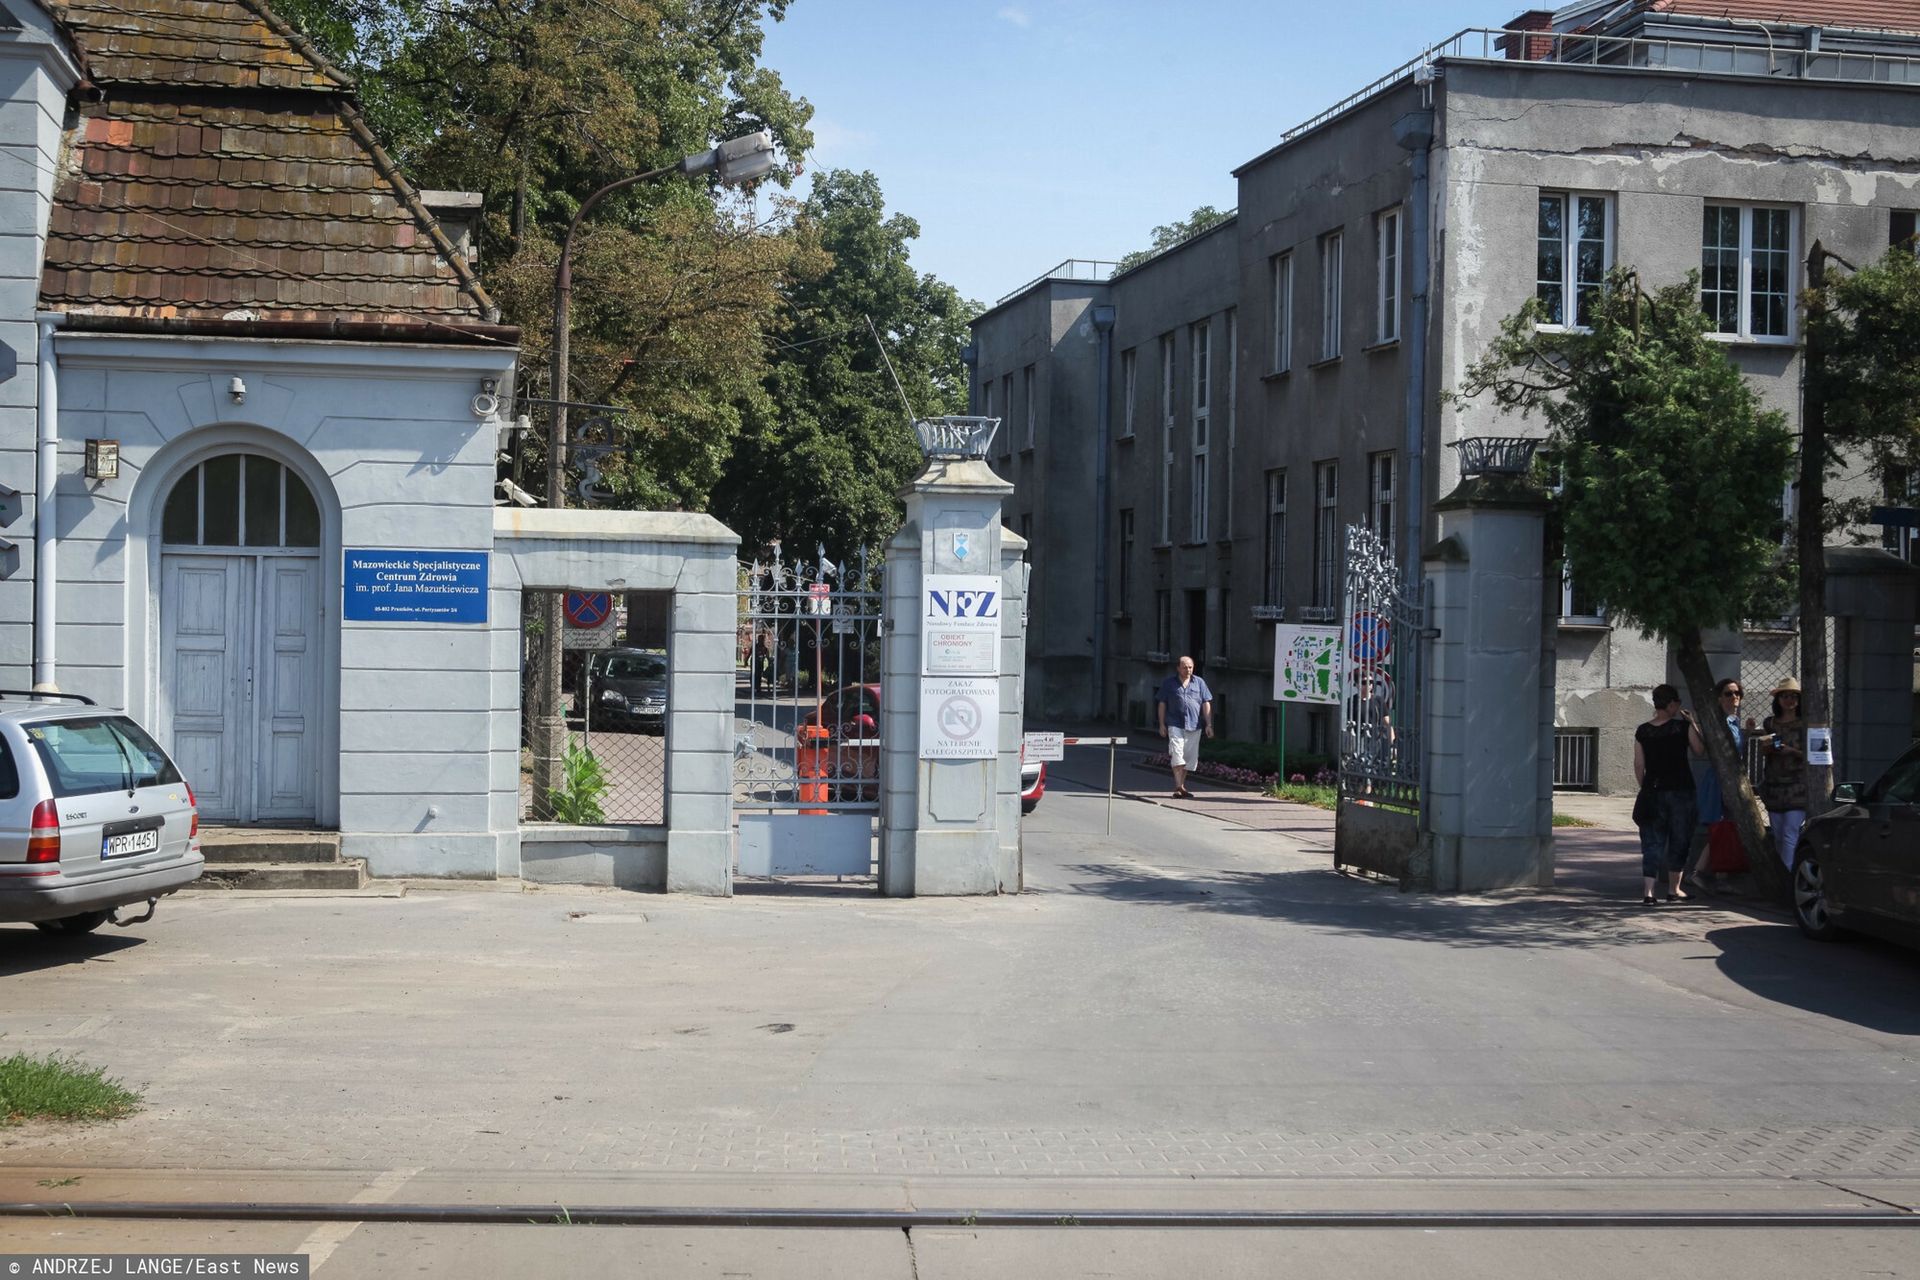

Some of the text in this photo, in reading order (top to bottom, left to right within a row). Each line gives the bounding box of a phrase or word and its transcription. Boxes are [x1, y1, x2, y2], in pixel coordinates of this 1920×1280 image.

[352, 560, 481, 571] Mazowieckie Specjalistyczne
[376, 571, 457, 582] Centrum Zdrowia
[355, 583, 479, 594] im. prof. Jana Mazurkiewicza
[927, 590, 998, 618] NFZ
[958, 748, 993, 756] SZPITALA
[108, 831, 156, 854] WPR 14451
